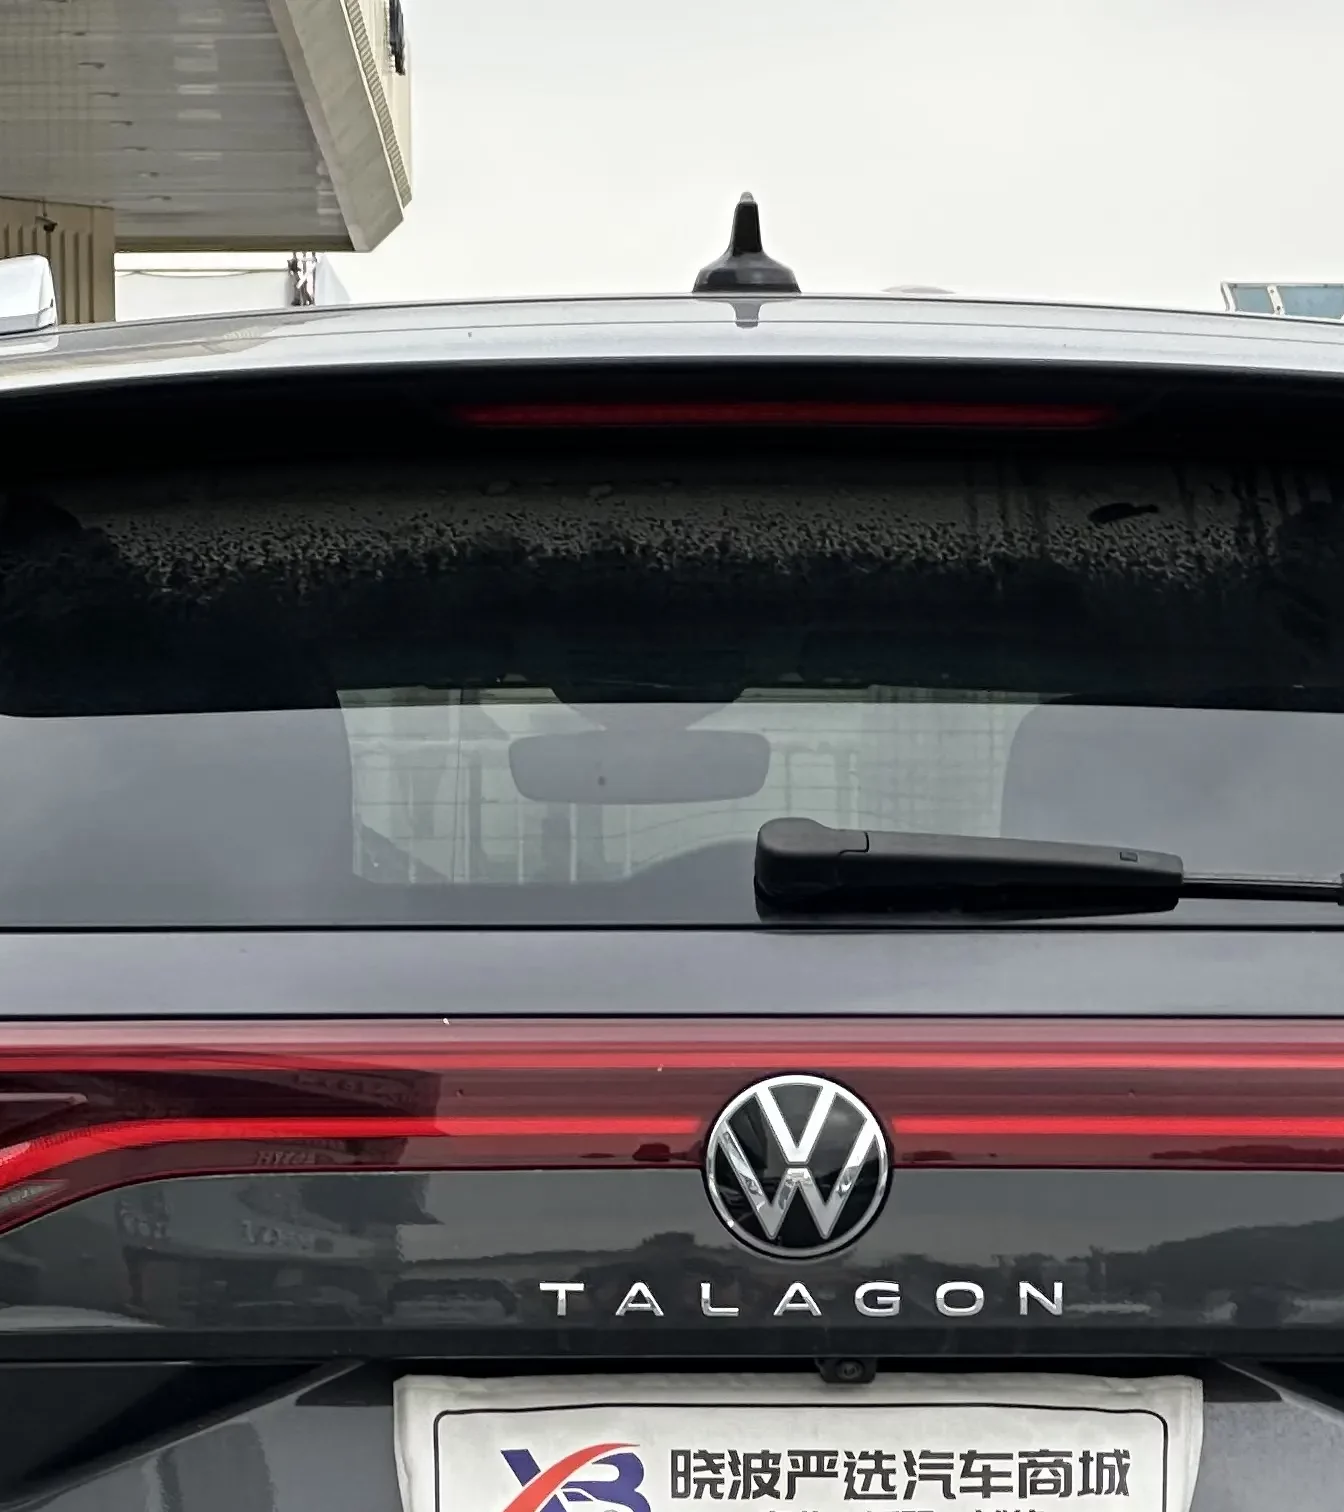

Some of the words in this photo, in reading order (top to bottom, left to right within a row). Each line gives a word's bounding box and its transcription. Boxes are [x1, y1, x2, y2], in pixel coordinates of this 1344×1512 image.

[539, 1281, 1065, 1318] TALAGON
[669, 1448, 1131, 1501] 晓波严选汽车商城
